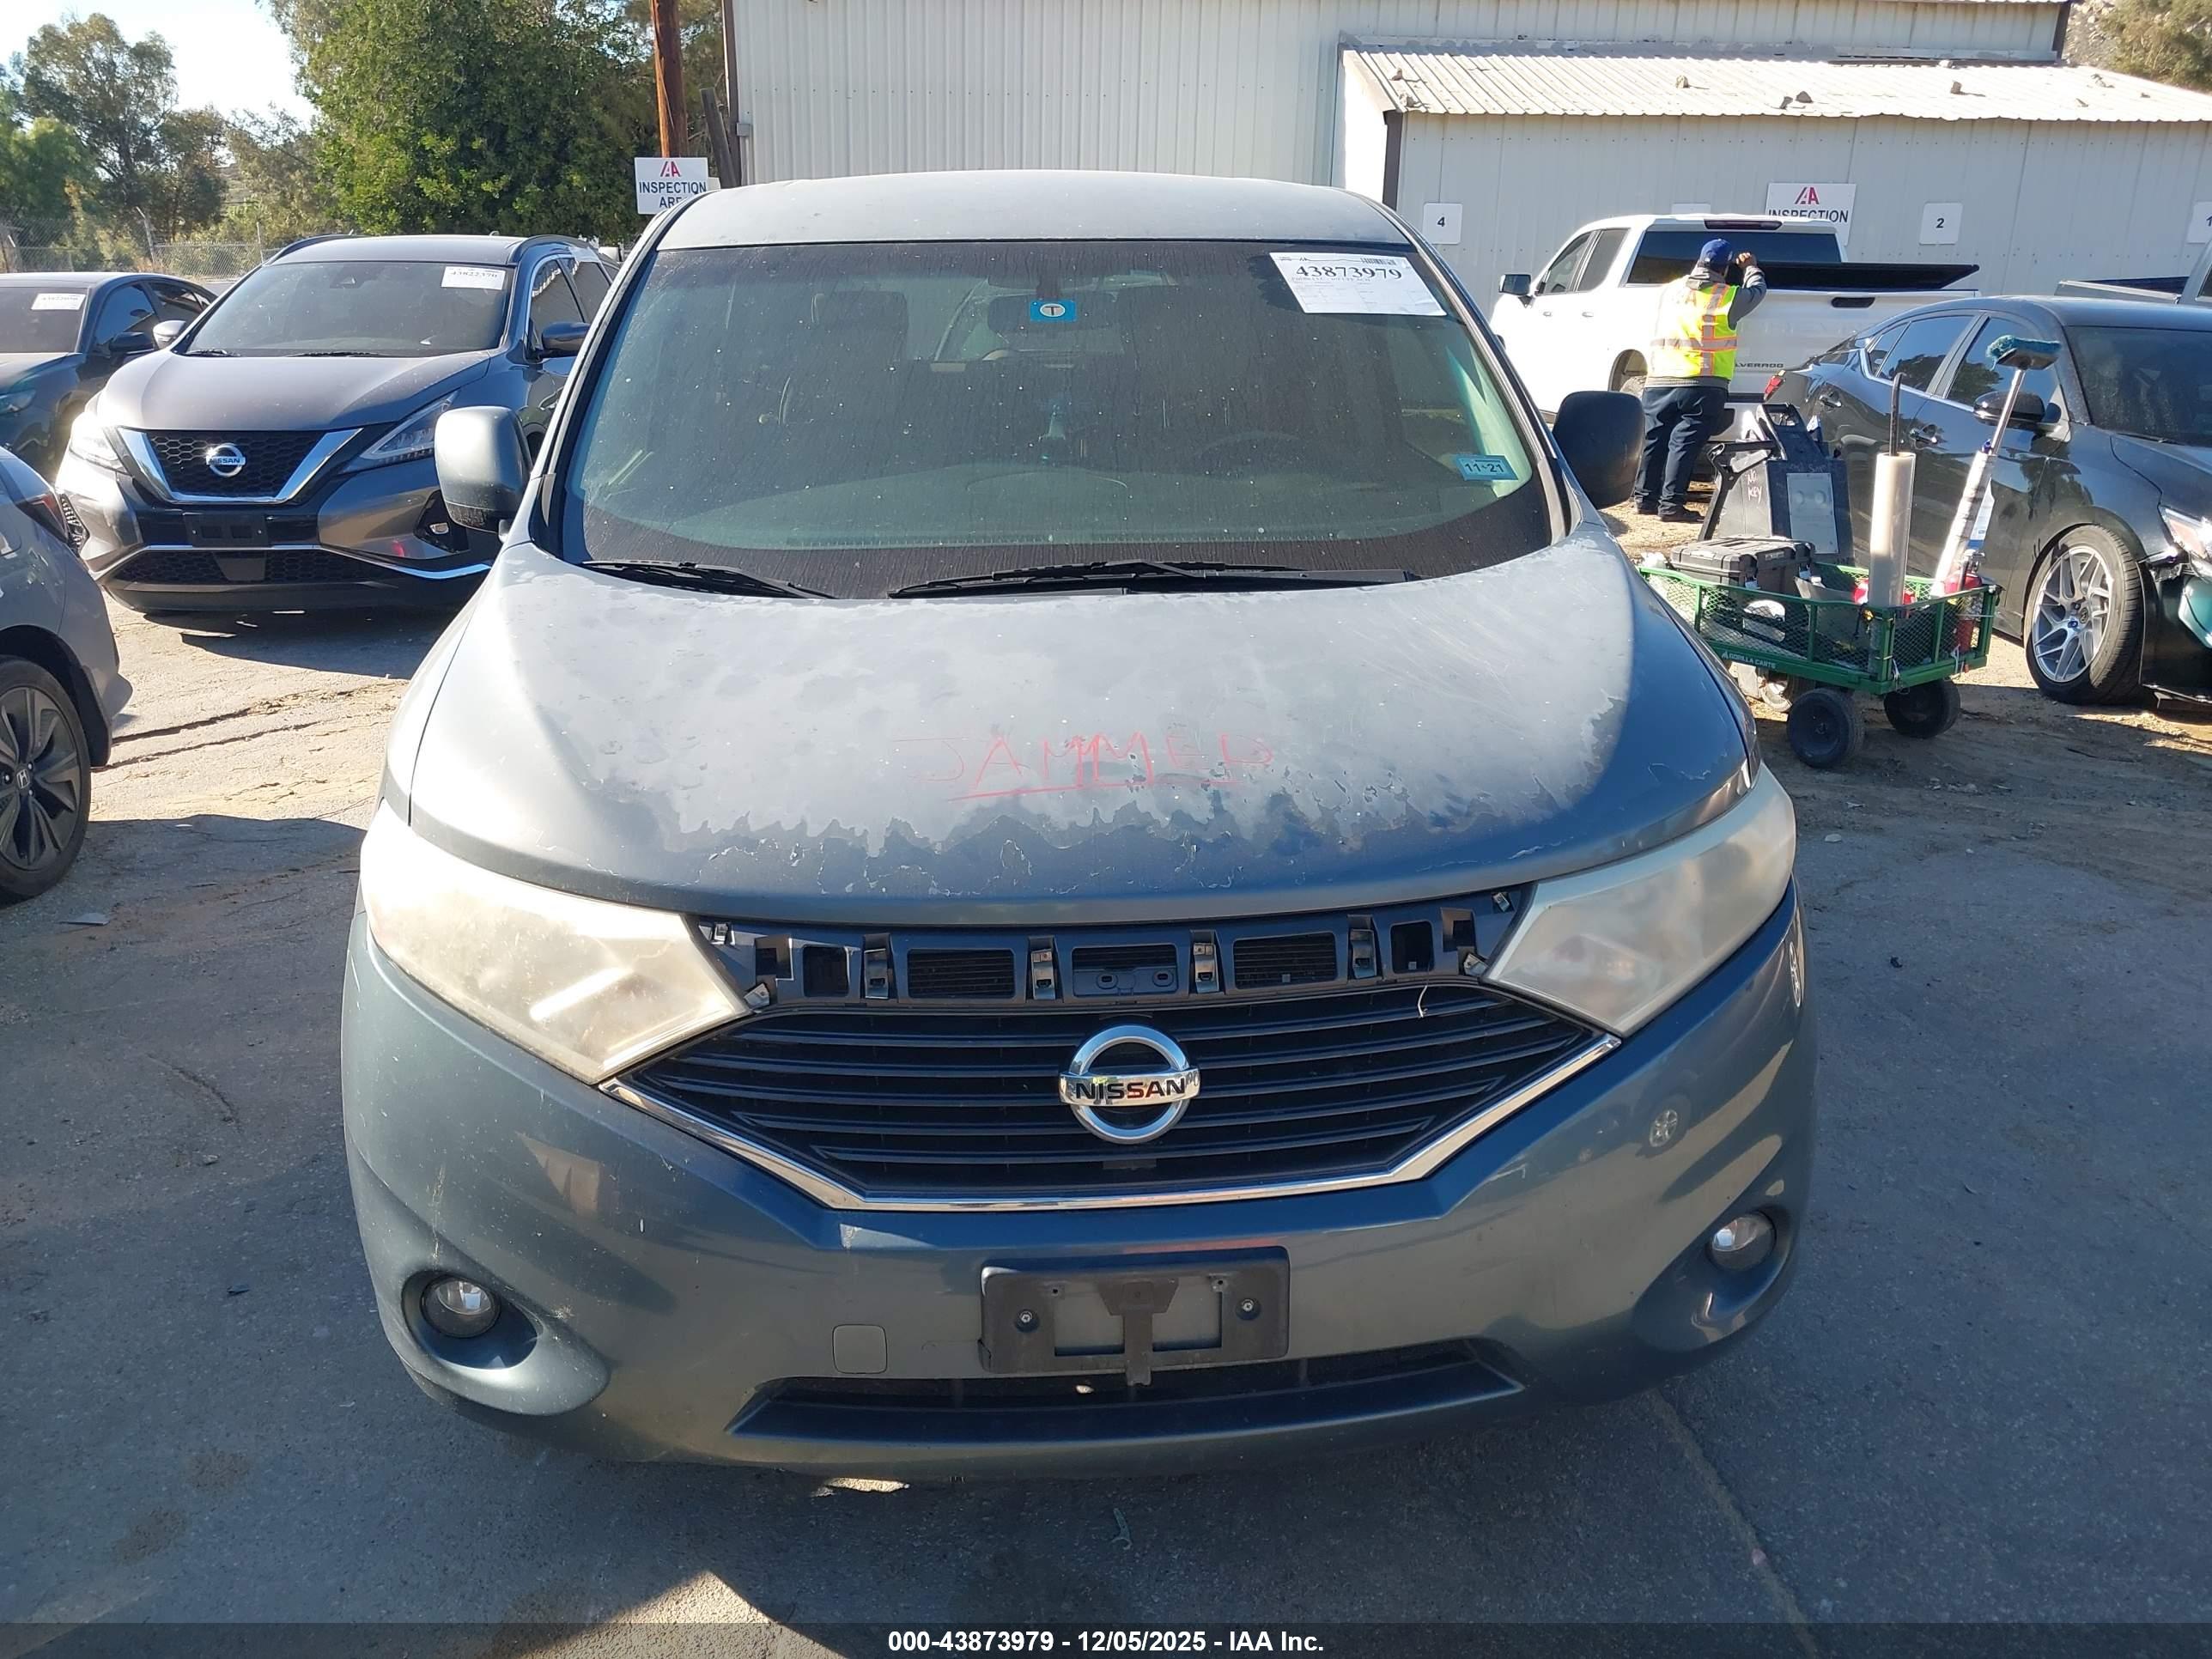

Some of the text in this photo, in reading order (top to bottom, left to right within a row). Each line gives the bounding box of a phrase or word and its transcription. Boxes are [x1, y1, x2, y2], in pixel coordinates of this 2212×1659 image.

[639, 182, 707, 194] INSPECTION
[1437, 216, 1445, 228] 4
[1936, 217, 1945, 228] 2
[1296, 265, 1402, 280] 43873979
[893, 732, 1274, 788] JAMMED
[1076, 1079, 1186, 1099] NISSAN
